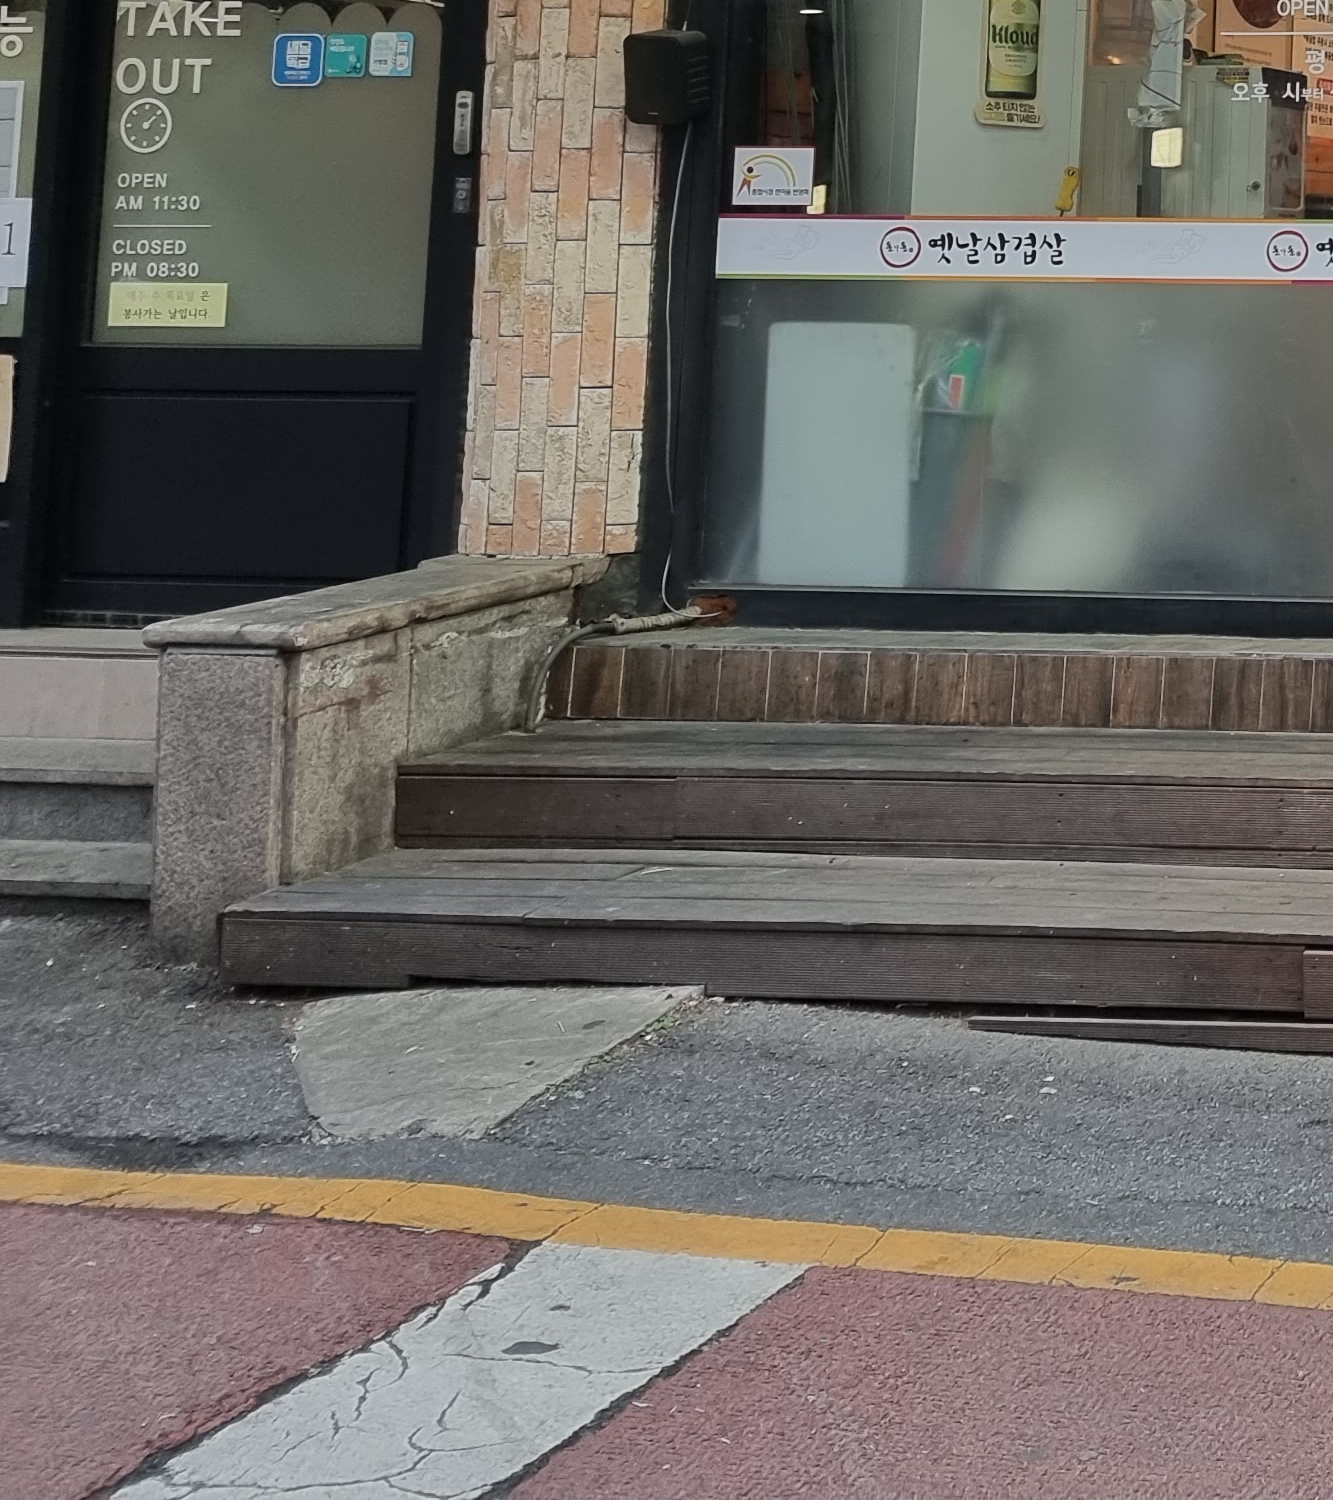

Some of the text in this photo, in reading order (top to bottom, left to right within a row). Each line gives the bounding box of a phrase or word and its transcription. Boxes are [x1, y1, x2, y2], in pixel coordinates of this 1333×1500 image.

[119, 1, 243, 37] TAKE
[992, 24, 1039, 45] Kloud
[116, 58, 212, 94] OUT
[1230, 82, 1270, 102] 오후
[117, 173, 167, 188] OPEN
[115, 195, 200, 211] AM 11:30
[112, 240, 187, 255] CLOSED
[928, 232, 1067, 265] 옛날삼겹살
[111, 262, 199, 277] PM 08:30
[124, 308, 208, 319] 봉사가는 날입니다
